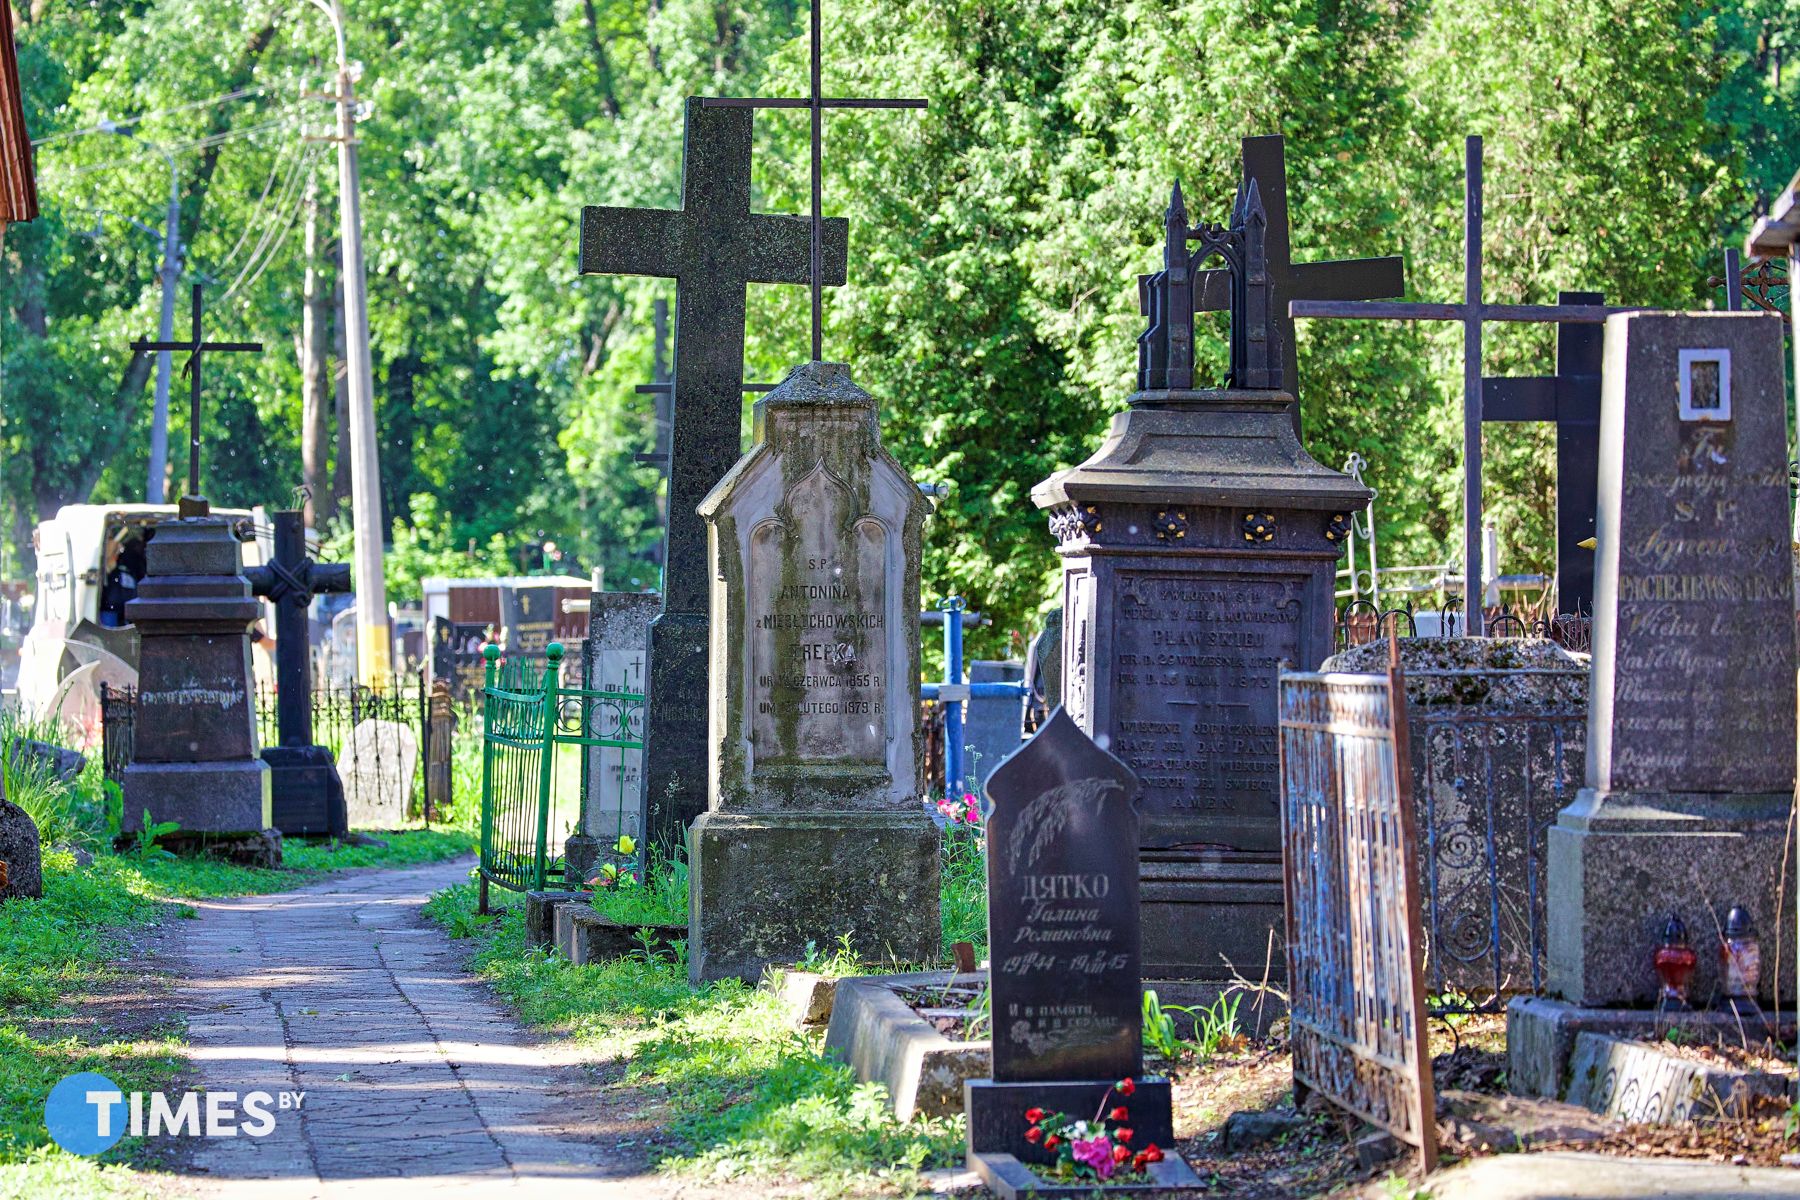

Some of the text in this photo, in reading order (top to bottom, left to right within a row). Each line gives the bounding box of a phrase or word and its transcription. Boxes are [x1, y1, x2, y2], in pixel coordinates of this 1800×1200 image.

[781, 586, 850, 599] ANTONINA
[793, 675, 841, 688] CZERWCA
[845, 674, 870, 687] 1855
[798, 702, 839, 714] LUTEGO
[1192, 722, 1280, 738] ODPOCZNIEN
[1020, 873, 1110, 905] ДЯТКО
[1026, 901, 1100, 922] Галина
